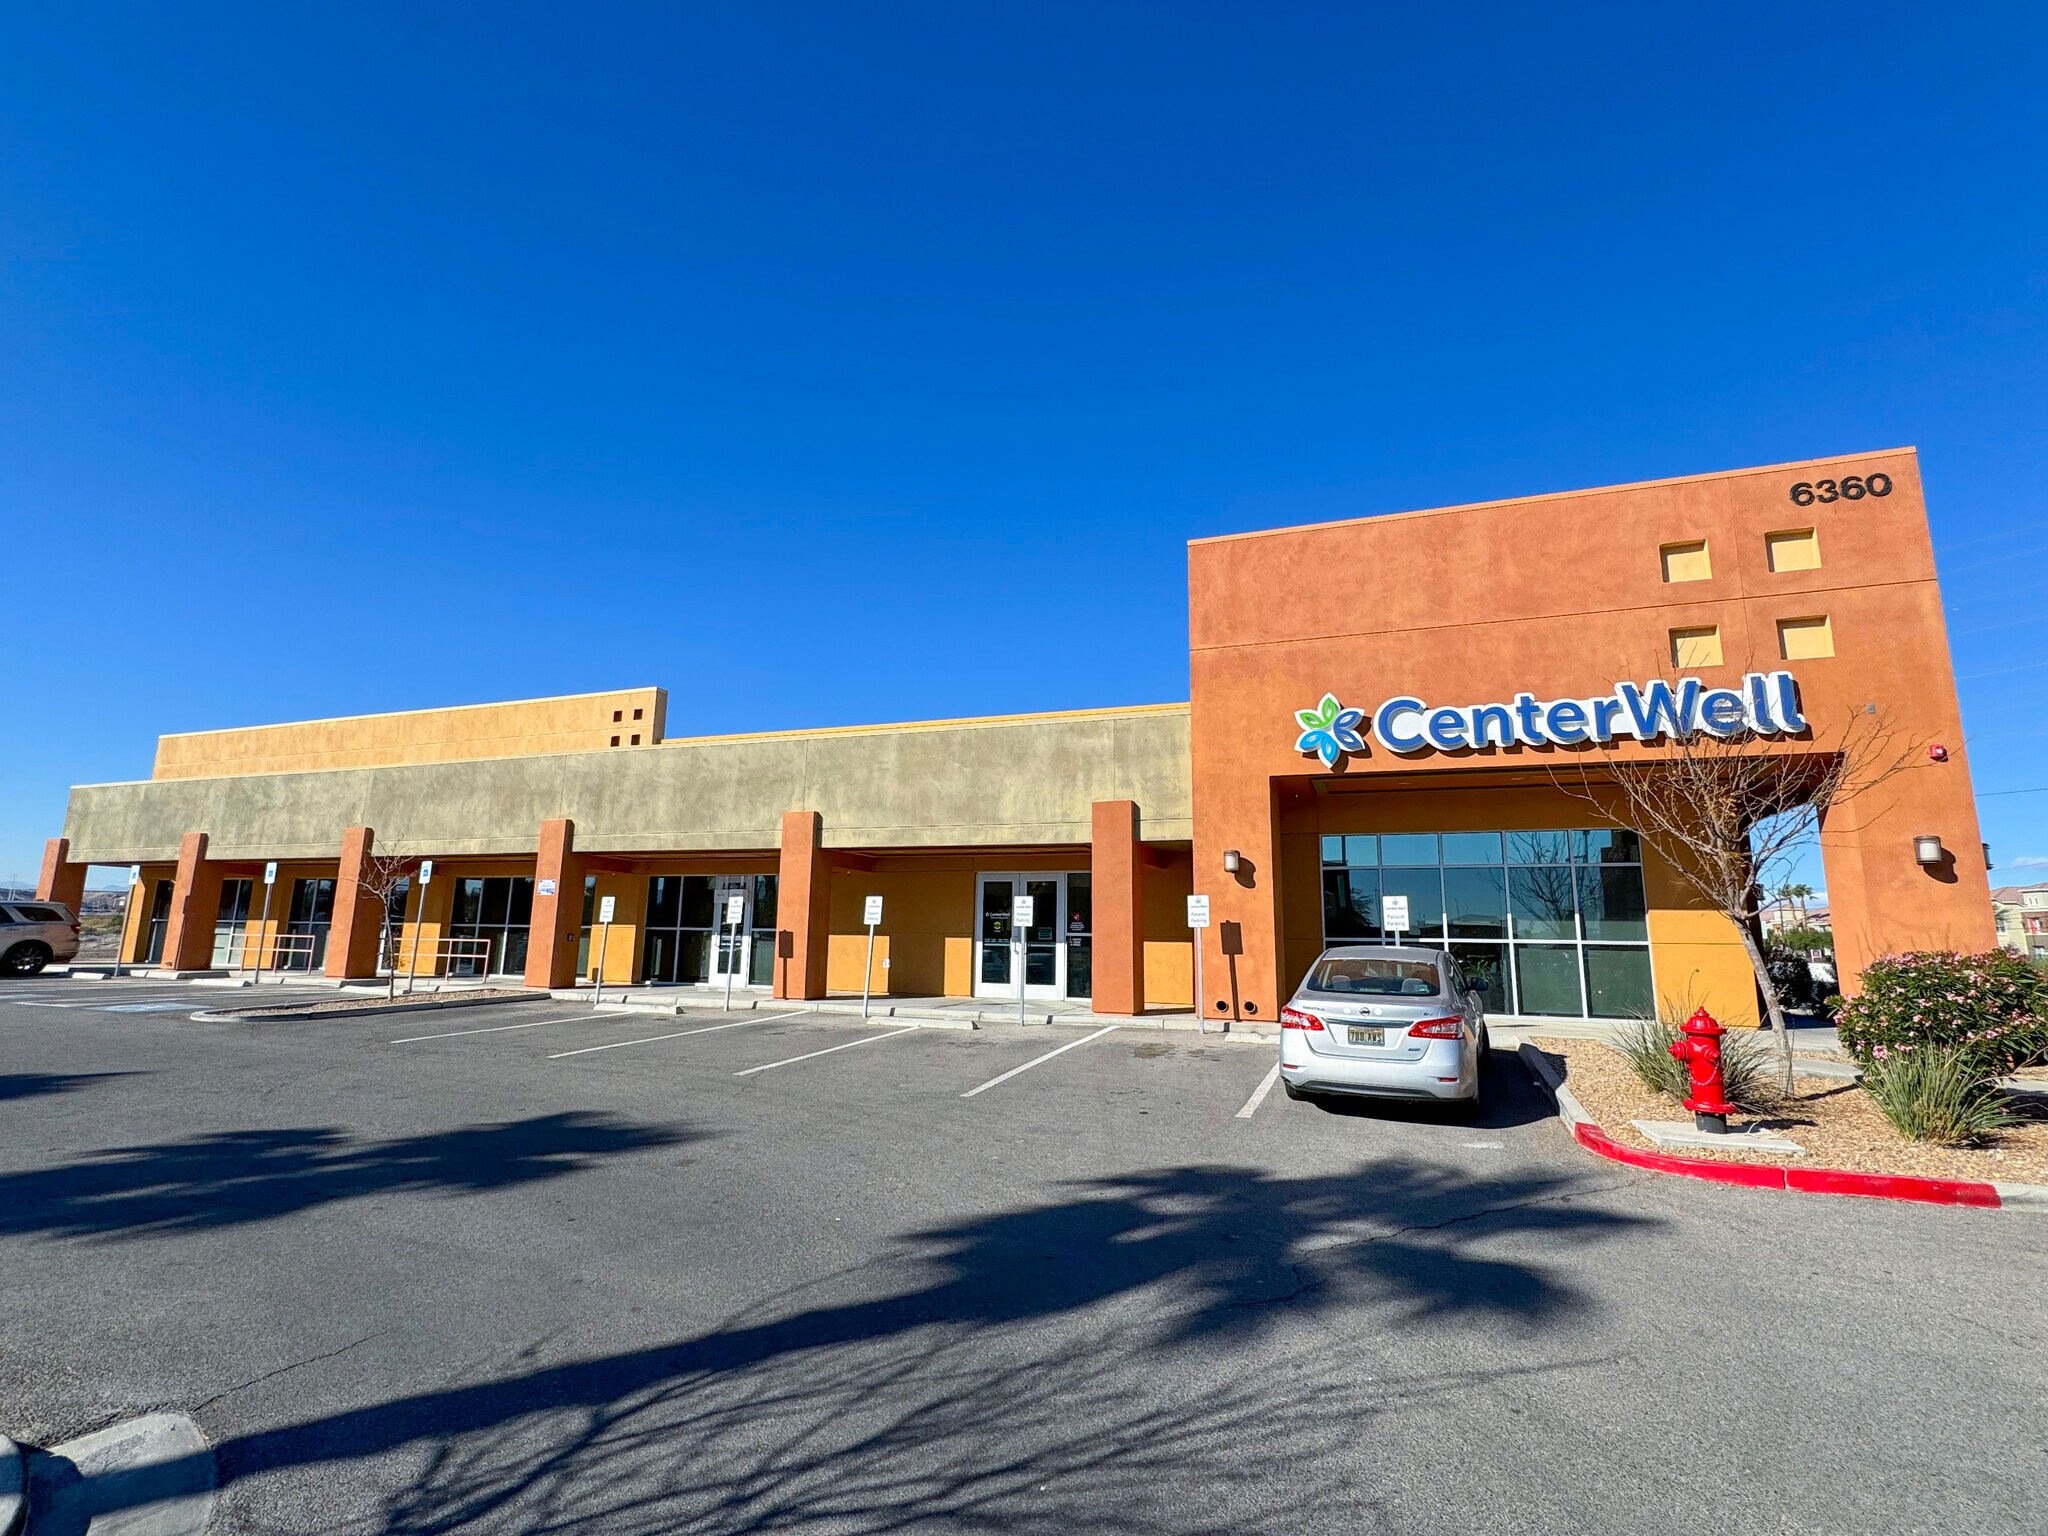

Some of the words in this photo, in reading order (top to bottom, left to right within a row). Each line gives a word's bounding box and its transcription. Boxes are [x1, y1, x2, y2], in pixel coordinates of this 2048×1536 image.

[1790, 473, 1892, 506] 6360
[1376, 673, 1805, 750] CenterWell
[1367, 1032, 1382, 1042] AWS
